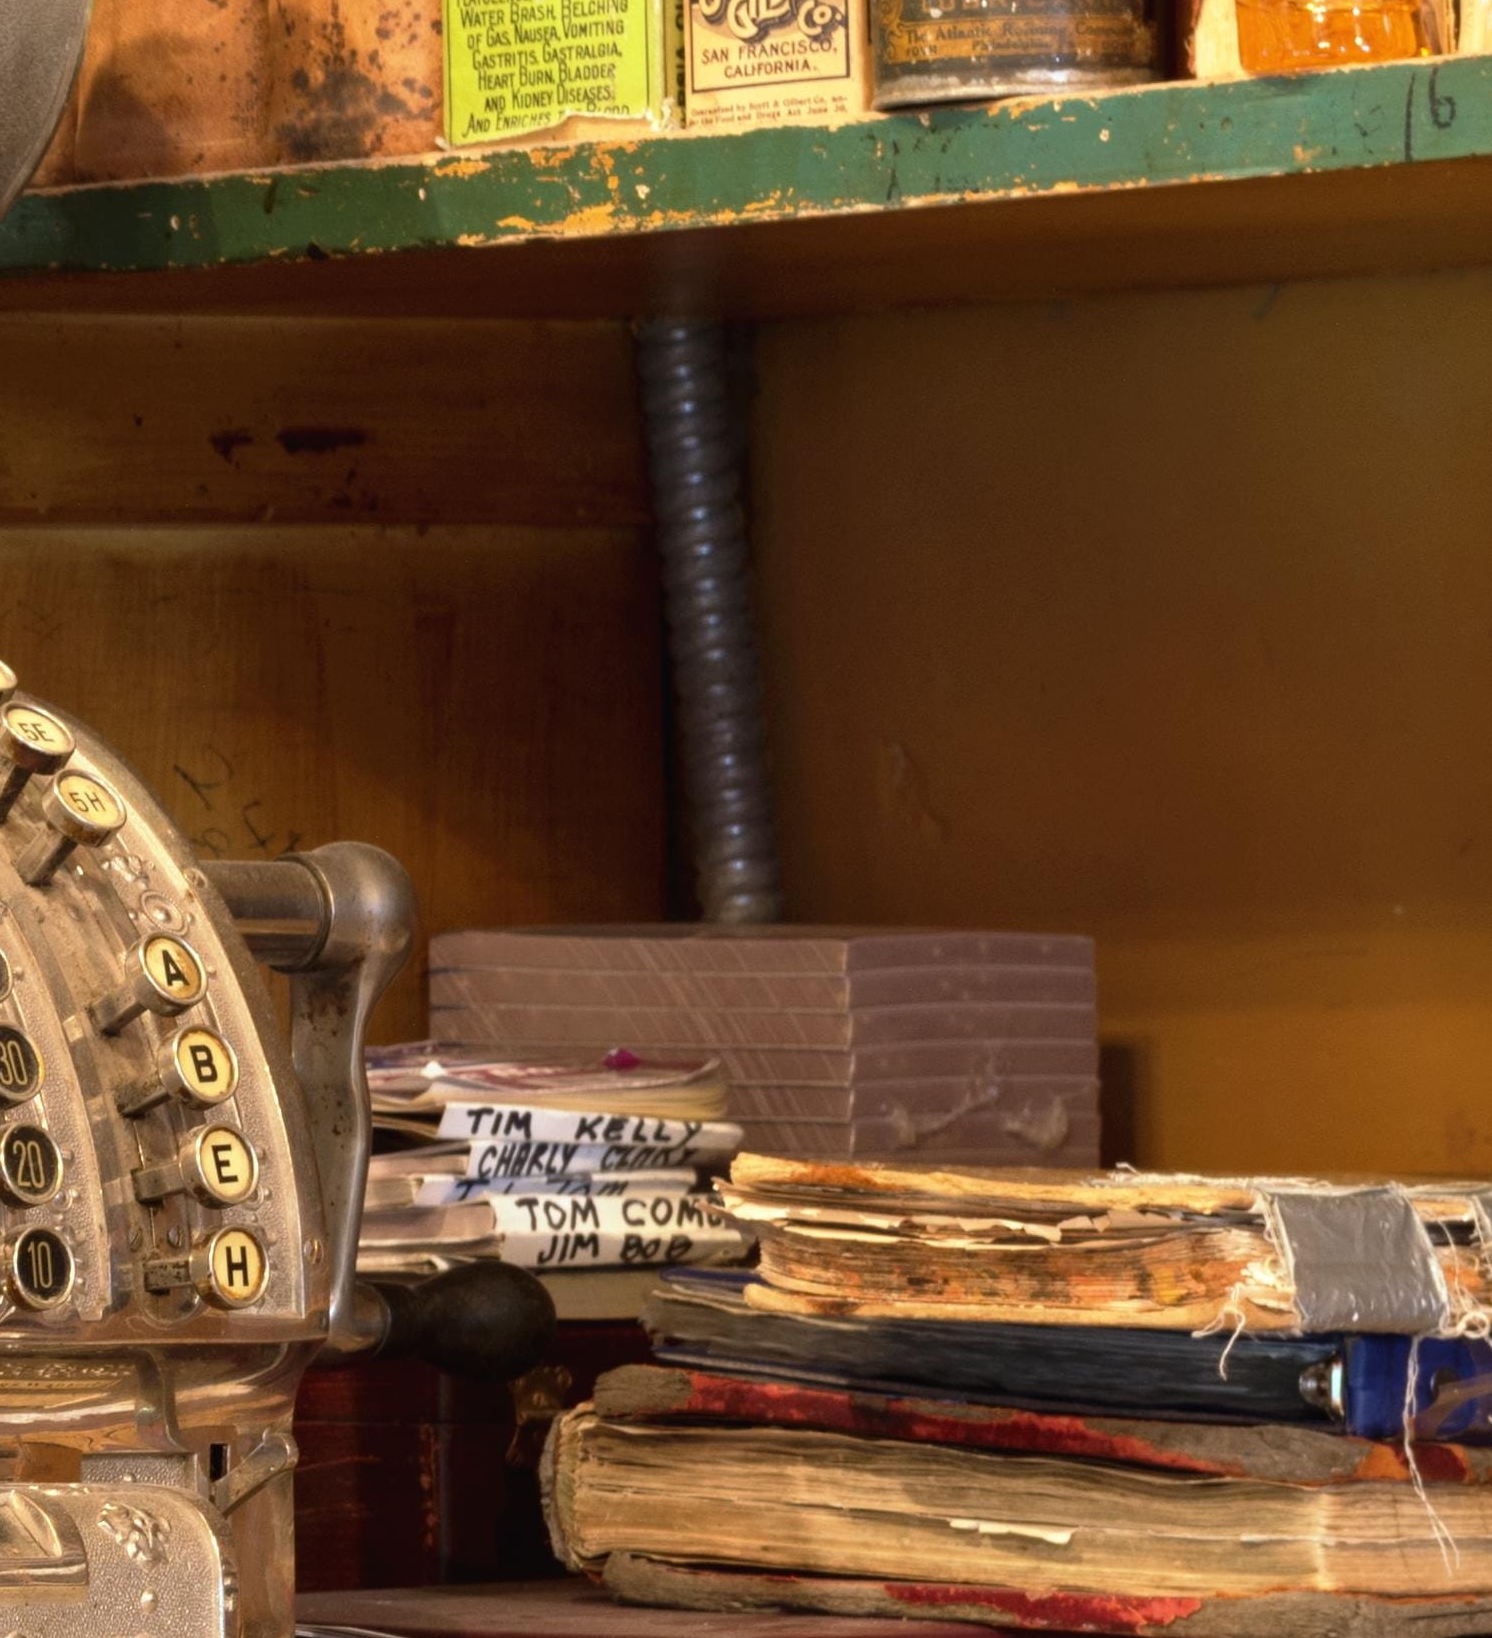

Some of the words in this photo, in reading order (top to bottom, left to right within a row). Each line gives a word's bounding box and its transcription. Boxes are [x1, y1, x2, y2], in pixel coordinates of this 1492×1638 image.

[459, 9, 505, 29] WATER
[701, 48, 729, 64] SAN
[478, 70, 515, 92] HEART
[558, 62, 616, 83] BLADDER
[512, 90, 554, 109] KIDNEY
[17, 721, 53, 744] 5E
[70, 789, 108, 814] 5H
[161, 949, 189, 988] A
[189, 1044, 219, 1083] B
[468, 1107, 532, 1137] TIM
[574, 1115, 702, 1151] KELLY
[12, 1140, 46, 1189] 20
[211, 1144, 238, 1185] E
[514, 1197, 600, 1231] TOM
[27, 1240, 54, 1289] 10
[537, 1234, 600, 1264] JIM
[620, 1234, 692, 1259] BOB
[225, 1245, 249, 1288] H
